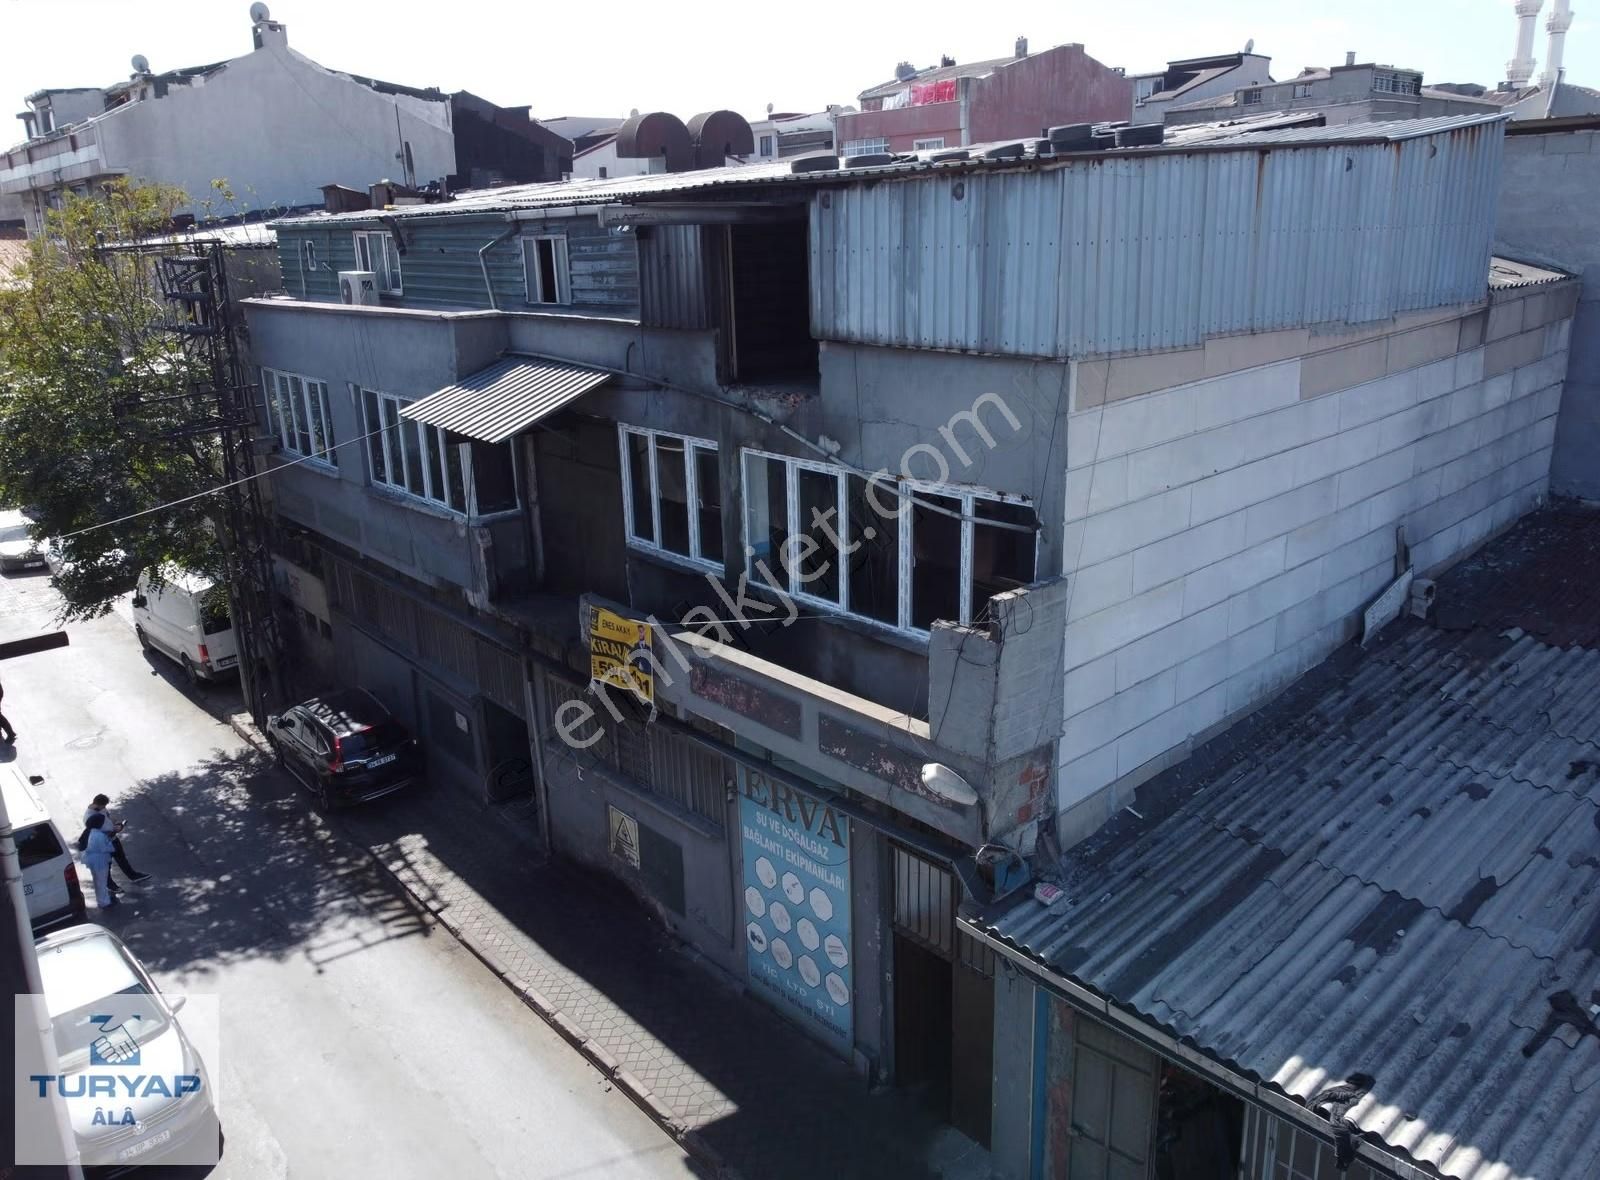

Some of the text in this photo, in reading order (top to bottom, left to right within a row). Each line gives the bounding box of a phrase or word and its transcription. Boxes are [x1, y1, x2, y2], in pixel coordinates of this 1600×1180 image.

[744, 767, 846, 848] ERVA
[756, 811, 767, 827] SU
[769, 817, 781, 835] VE
[786, 978, 807, 997] LTD
